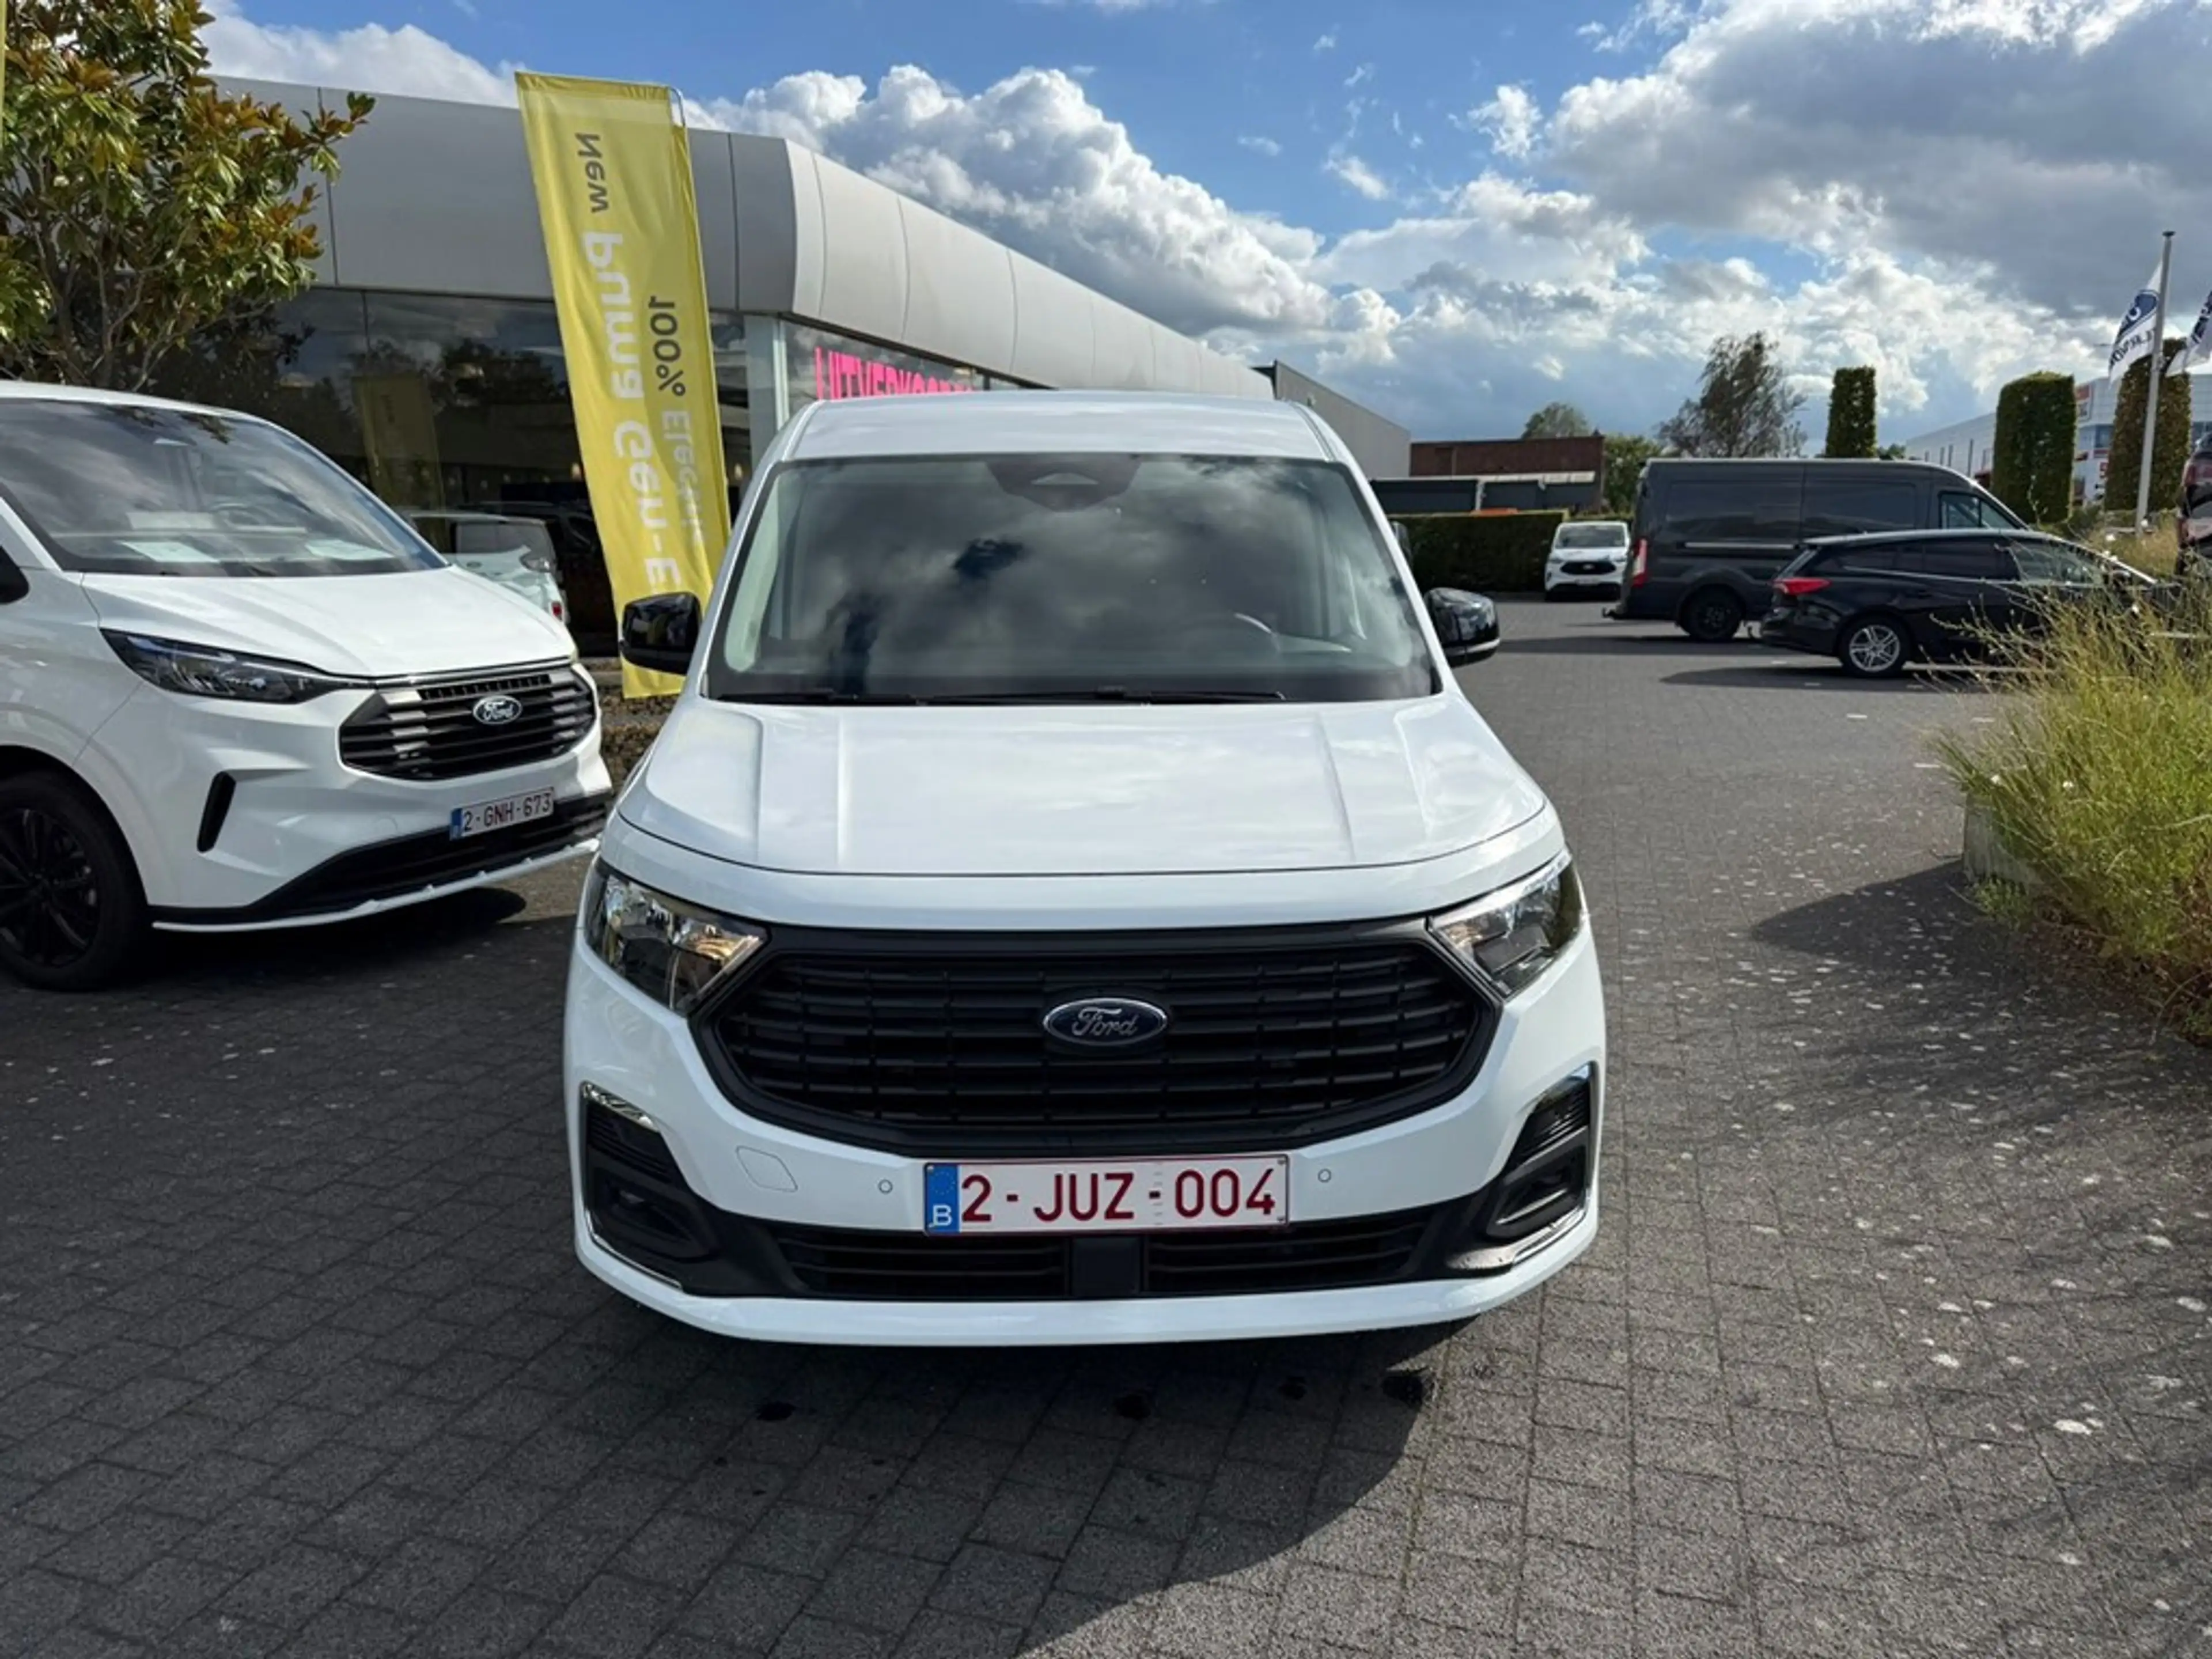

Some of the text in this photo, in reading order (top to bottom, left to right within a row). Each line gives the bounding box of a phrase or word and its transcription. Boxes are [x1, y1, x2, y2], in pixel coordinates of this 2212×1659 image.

[1071, 1007, 1139, 1035] Ford
[961, 1168, 1275, 1222] 2-JUZ-004
[933, 1204, 953, 1226] B
